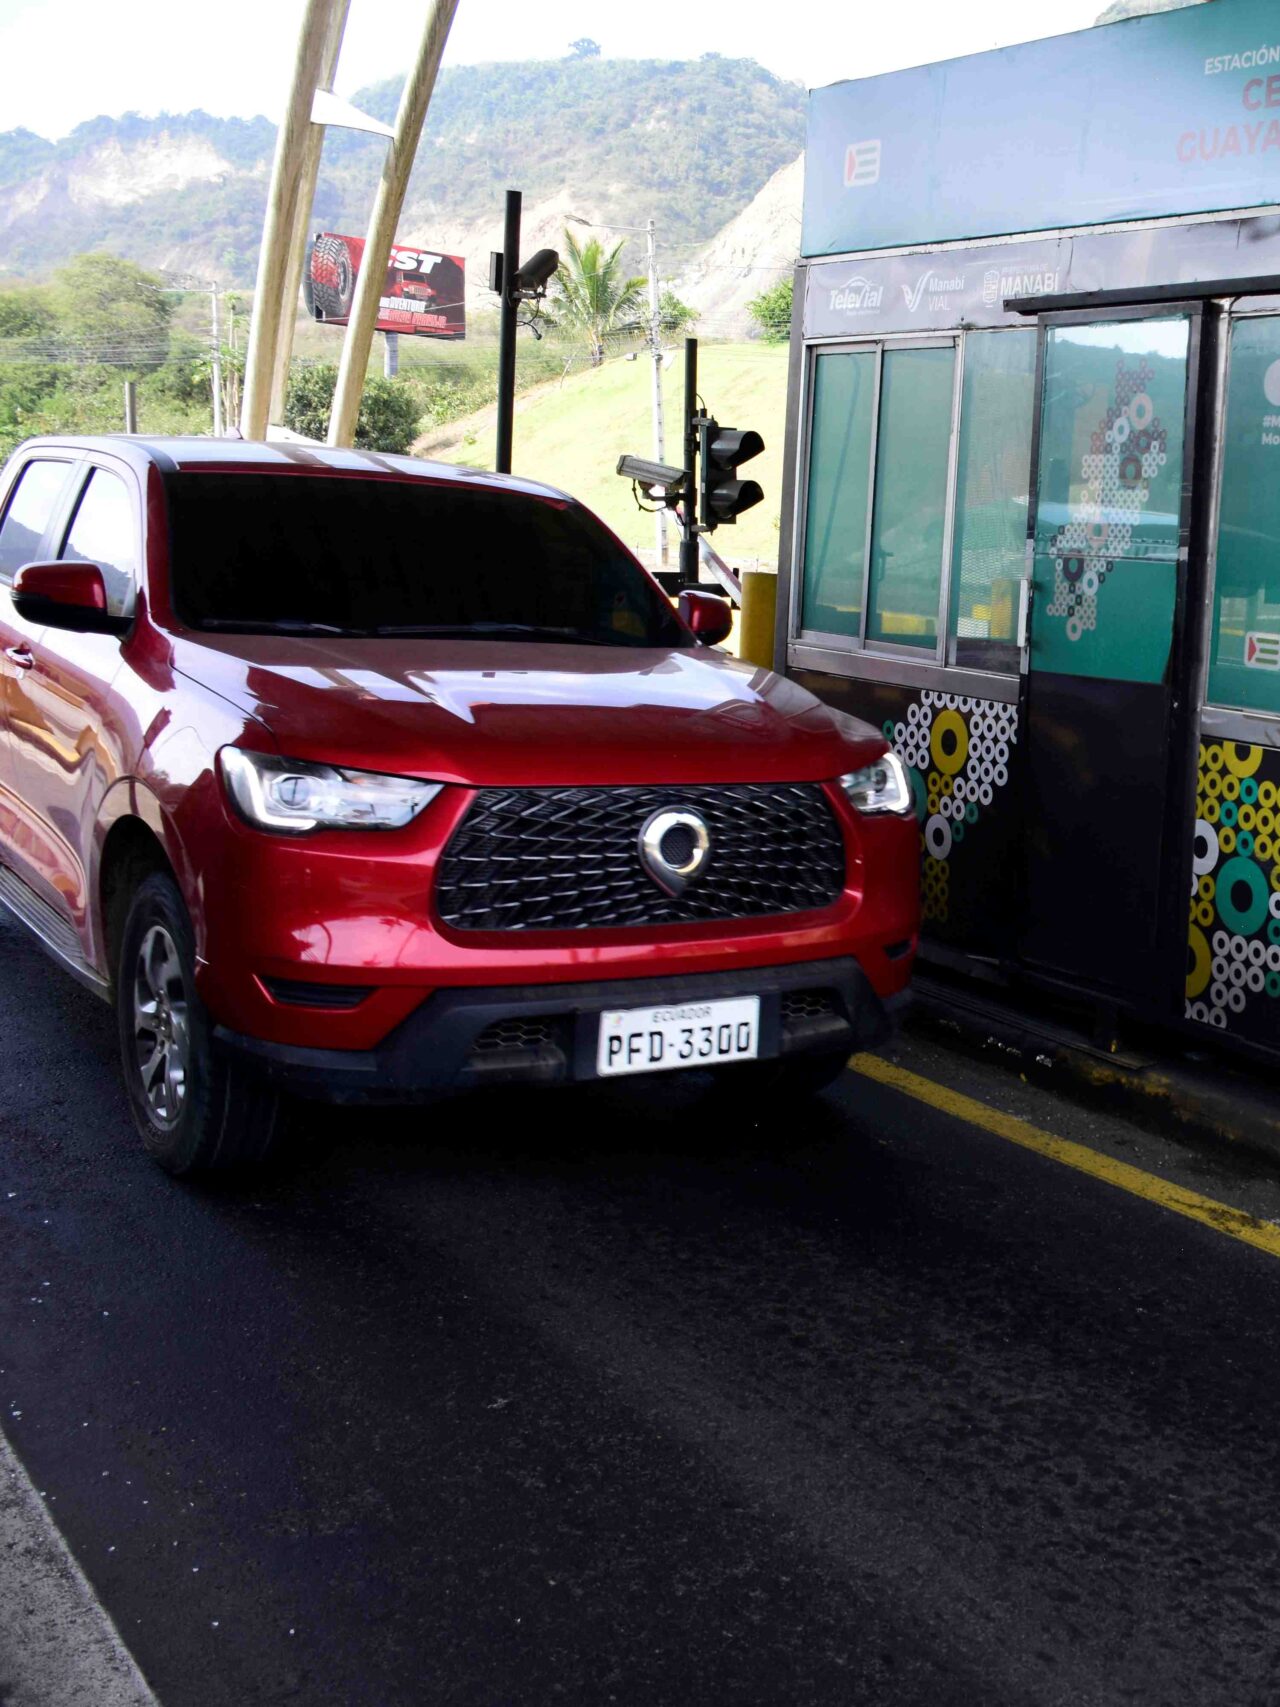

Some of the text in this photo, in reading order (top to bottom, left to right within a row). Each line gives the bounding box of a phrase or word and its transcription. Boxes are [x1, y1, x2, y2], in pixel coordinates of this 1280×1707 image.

[1204, 45, 1280, 75] ESTACIÓN
[929, 276, 964, 293] Manabí
[1000, 267, 1060, 296] MANABÍ
[928, 295, 952, 311] VIAL
[652, 1006, 712, 1024] ECUADOR
[607, 1021, 751, 1067] PFD-3300
